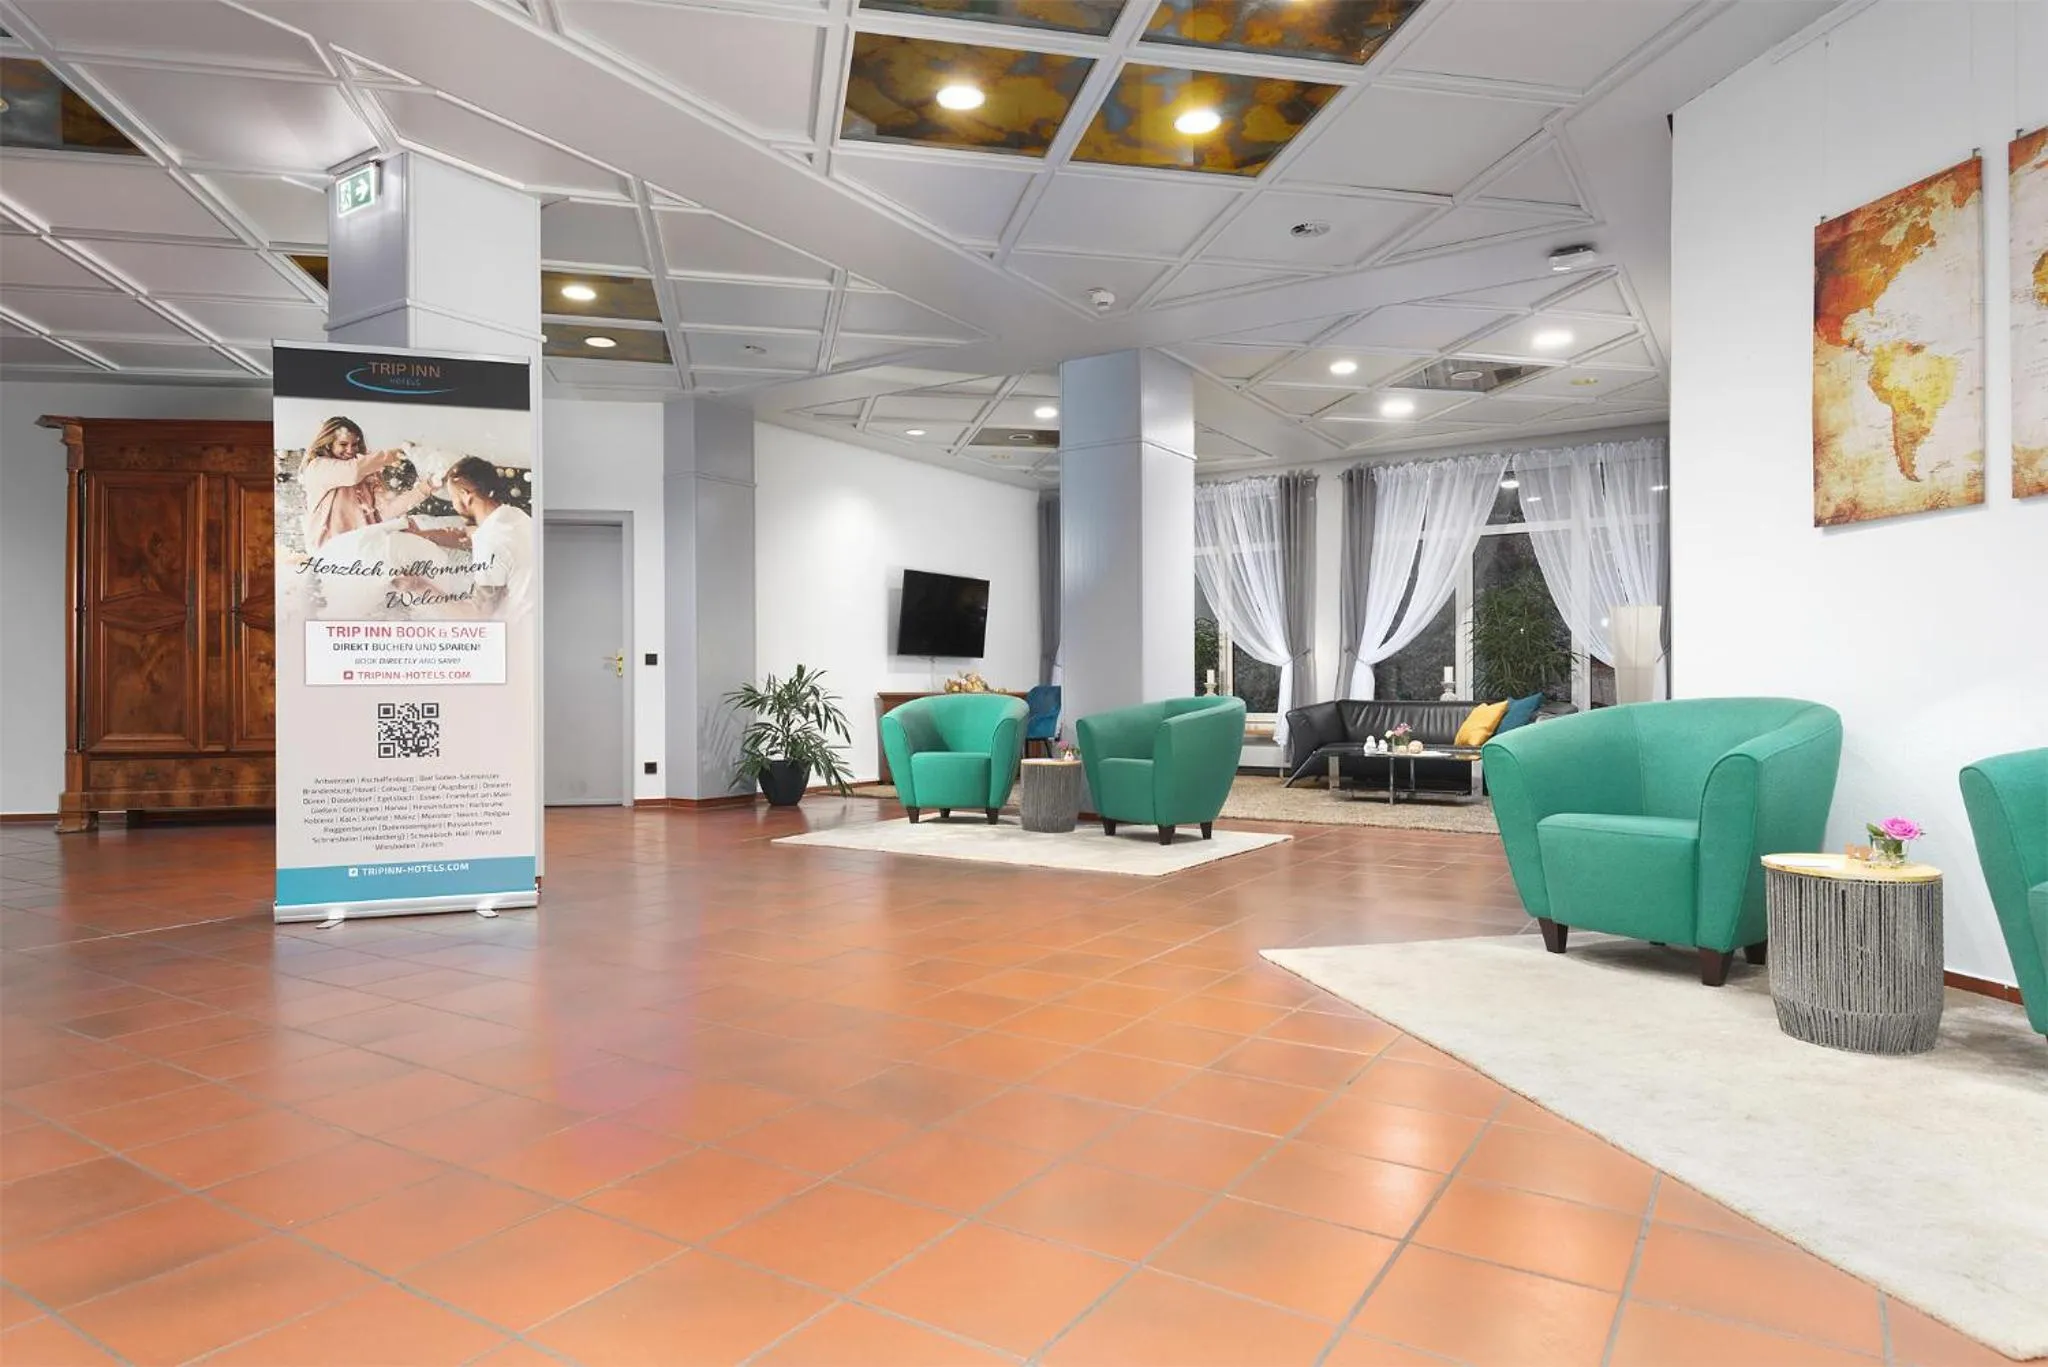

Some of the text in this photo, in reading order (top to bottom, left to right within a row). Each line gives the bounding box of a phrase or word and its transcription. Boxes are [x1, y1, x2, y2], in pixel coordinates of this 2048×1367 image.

[368, 361, 440, 378] TRIP INN
[296, 553, 495, 579] Herzlich willkommen!
[385, 583, 475, 609] Welcome!
[326, 626, 361, 638] TRIP
[365, 626, 392, 638] INN
[396, 626, 436, 638] BOOK
[451, 627, 488, 638] SAVE
[333, 643, 481, 651] DIREKT BUCHEN UND SPAREN!
[357, 671, 471, 680] TRIPINN-HOTELS.COM
[362, 863, 469, 876] TRIPINN-HOTELS.COM
